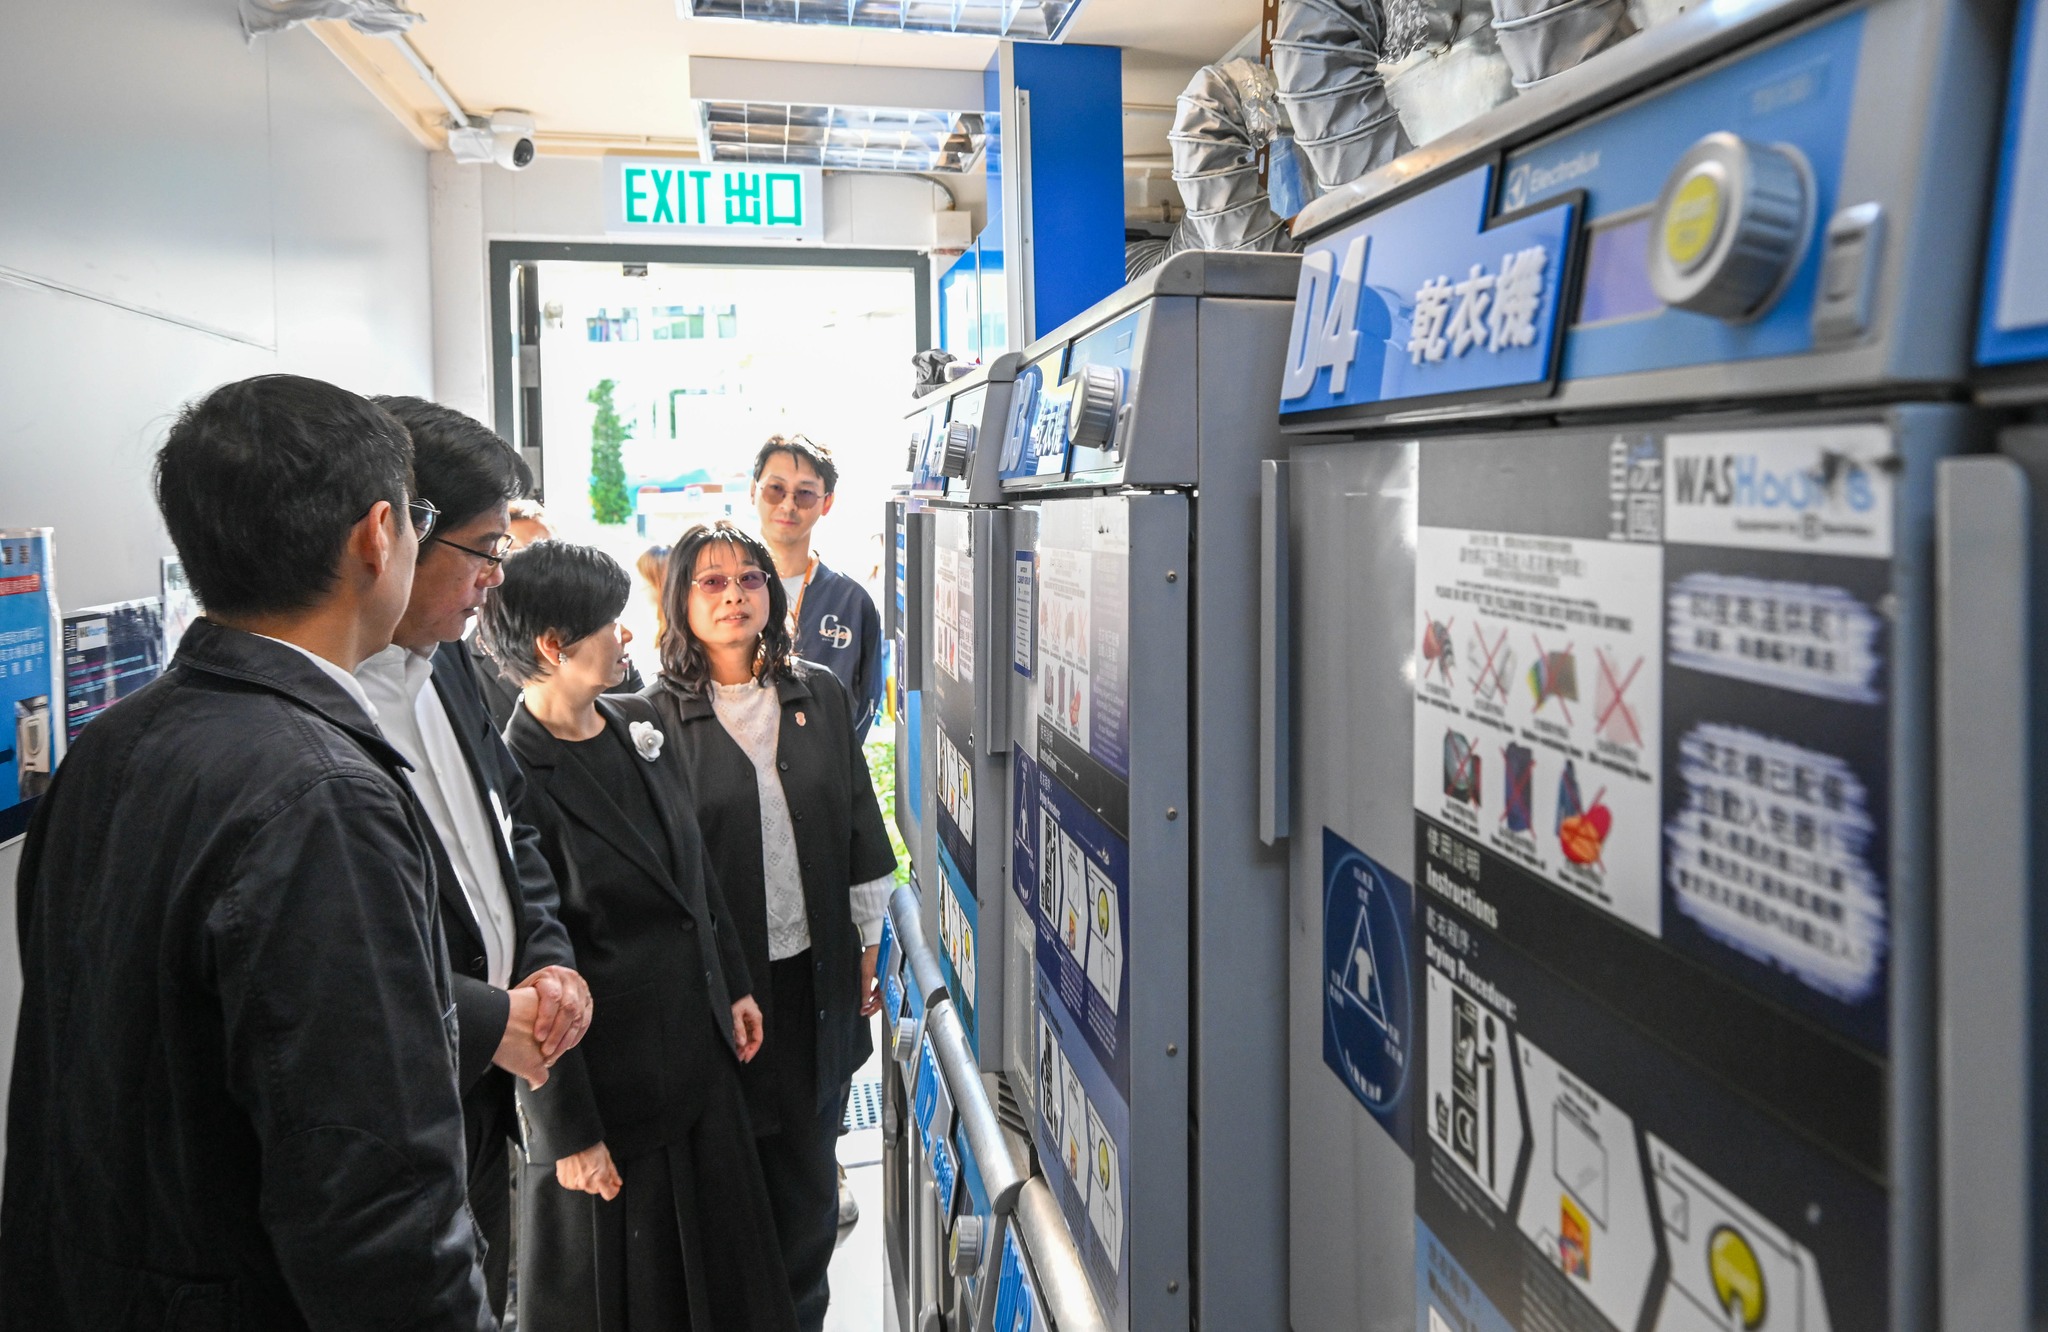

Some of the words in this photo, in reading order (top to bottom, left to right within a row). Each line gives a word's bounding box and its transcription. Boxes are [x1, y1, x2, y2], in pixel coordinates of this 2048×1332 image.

[625, 169, 711, 224] EXIT
[724, 172, 803, 226] 出口
[1282, 235, 1372, 400] D4
[1407, 245, 1548, 365] 乾衣機
[1426, 862, 1499, 929] Instructions
